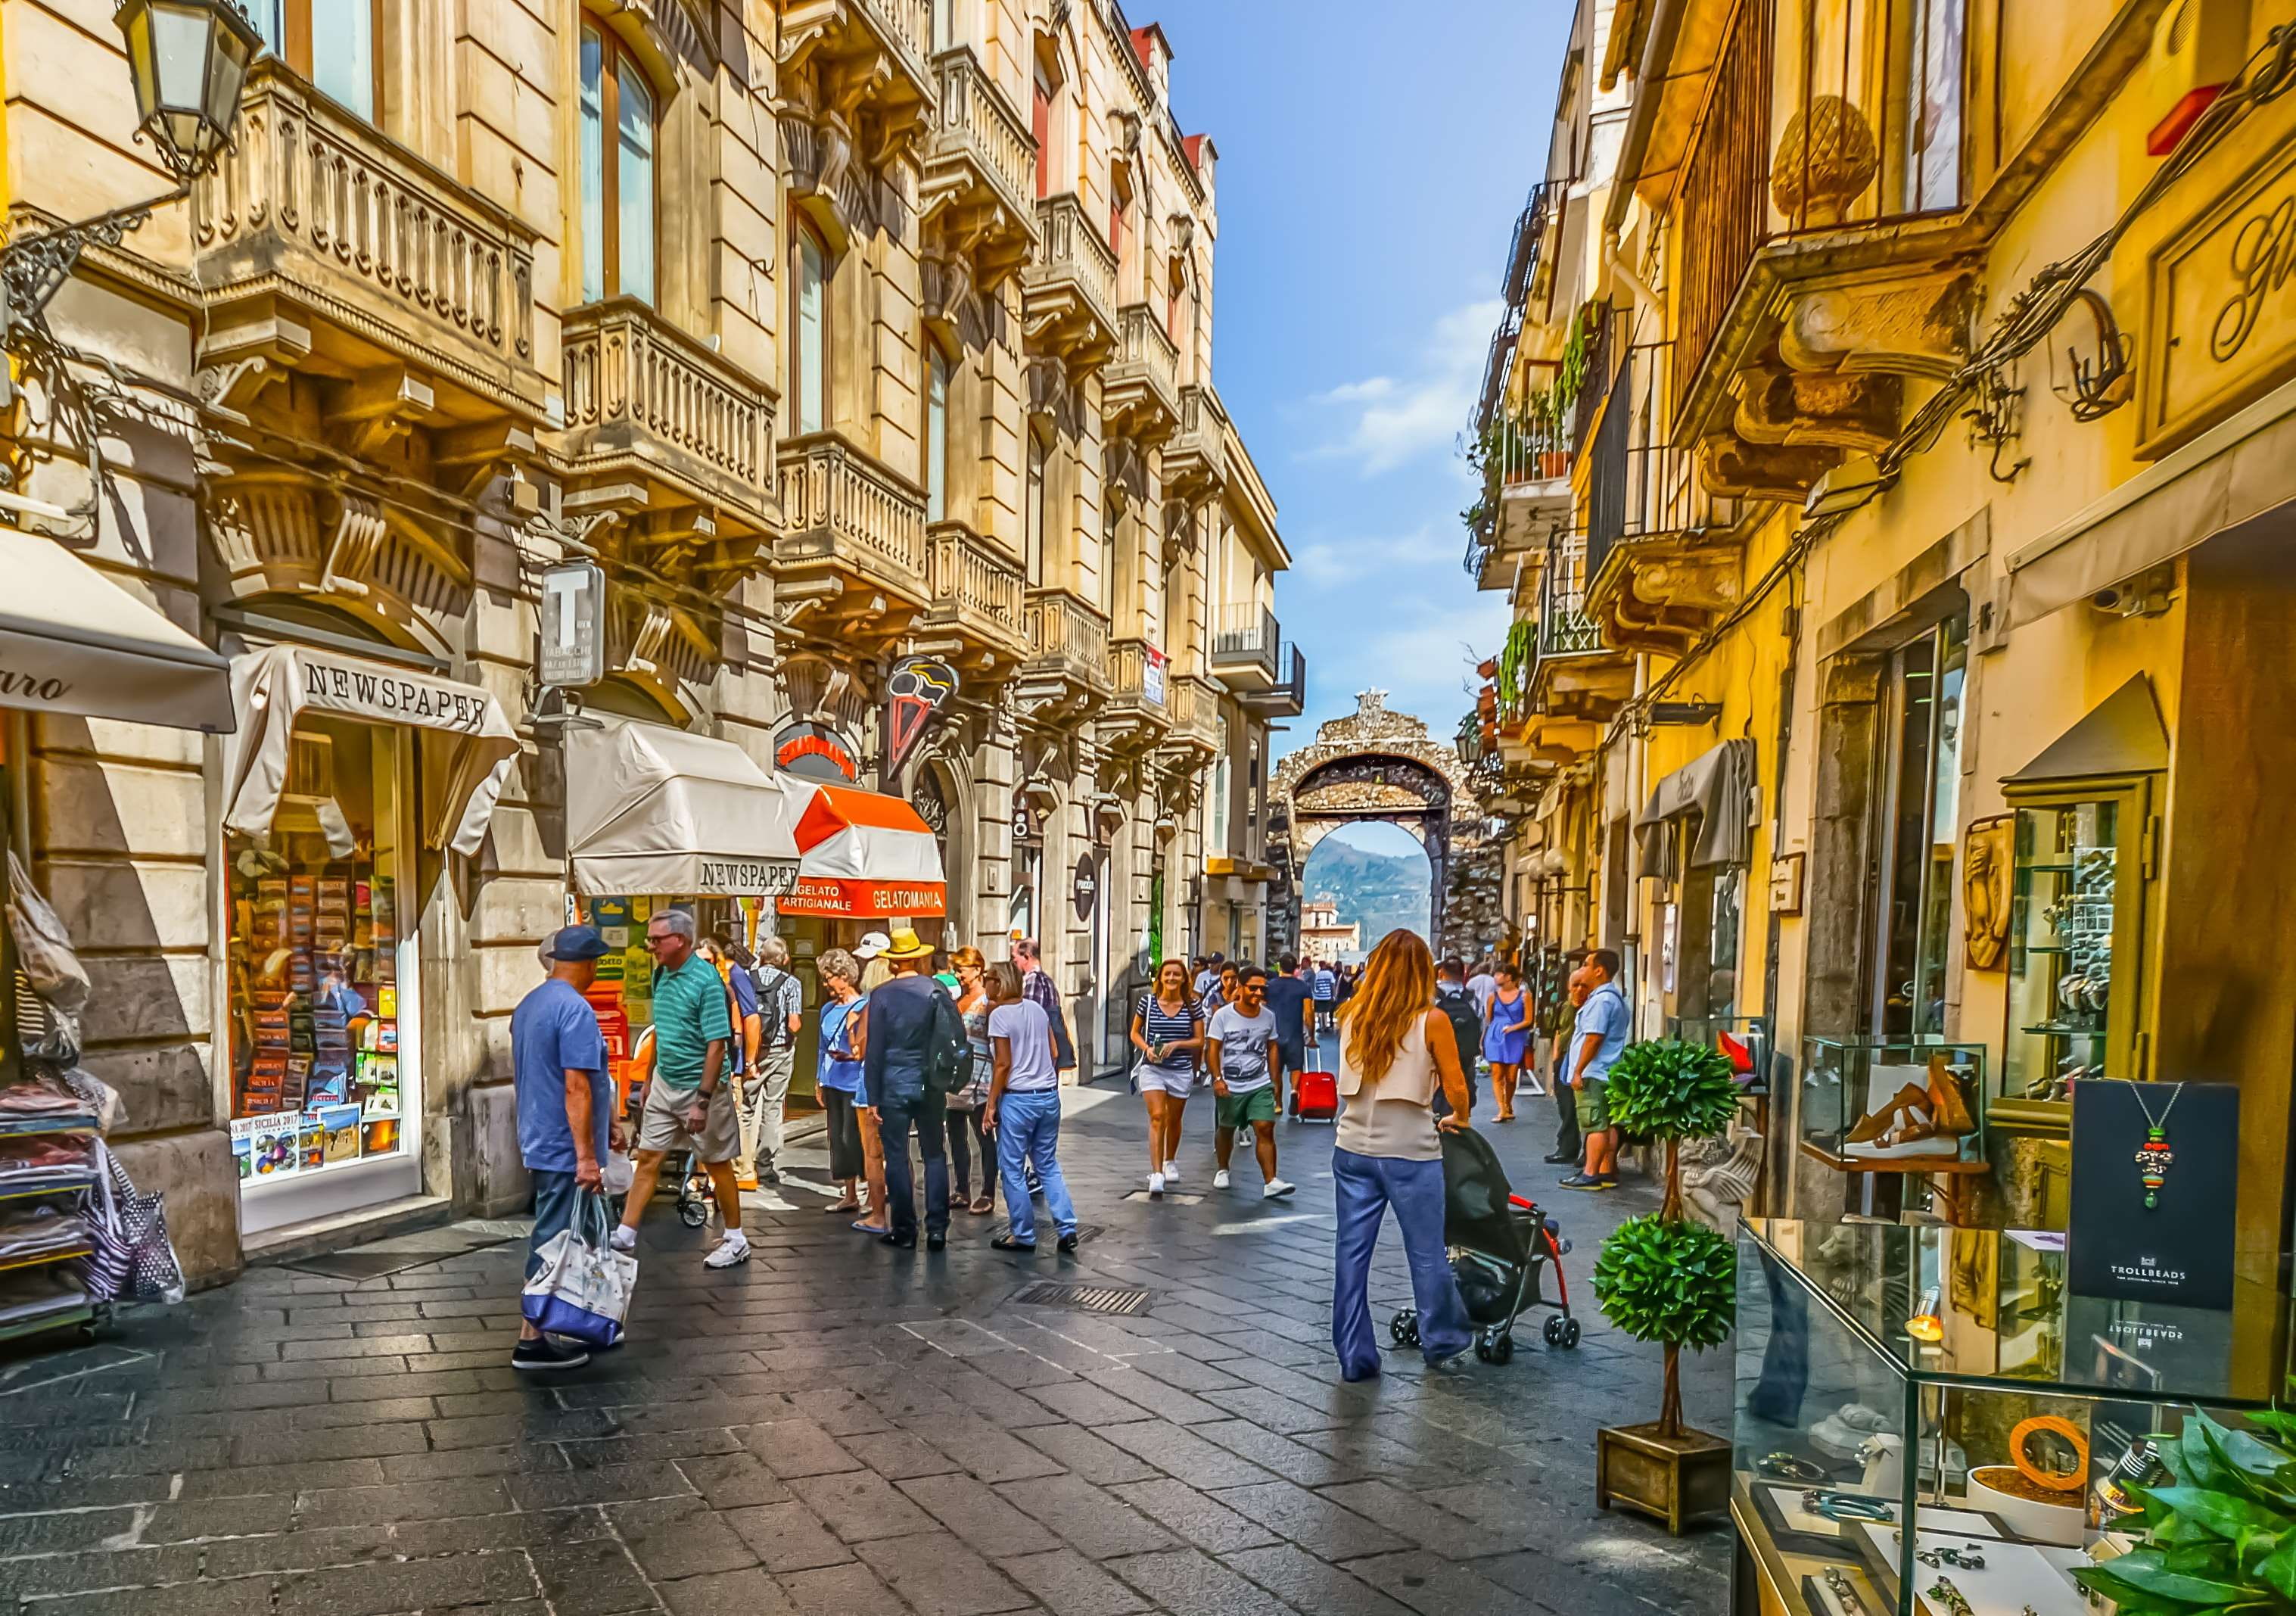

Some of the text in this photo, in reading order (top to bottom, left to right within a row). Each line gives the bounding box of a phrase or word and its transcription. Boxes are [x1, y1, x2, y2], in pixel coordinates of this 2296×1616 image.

[544, 570, 589, 649] T
[304, 662, 485, 727] NEWSPAPER
[798, 884, 839, 896] GELATO
[782, 897, 851, 911] ARTIGIANALE
[873, 889, 943, 909] GELATOMANIA
[254, 1117, 282, 1129] SICILIA
[283, 1113, 298, 1126] 2017
[2111, 1266, 2186, 1279] TROLLBEADS
